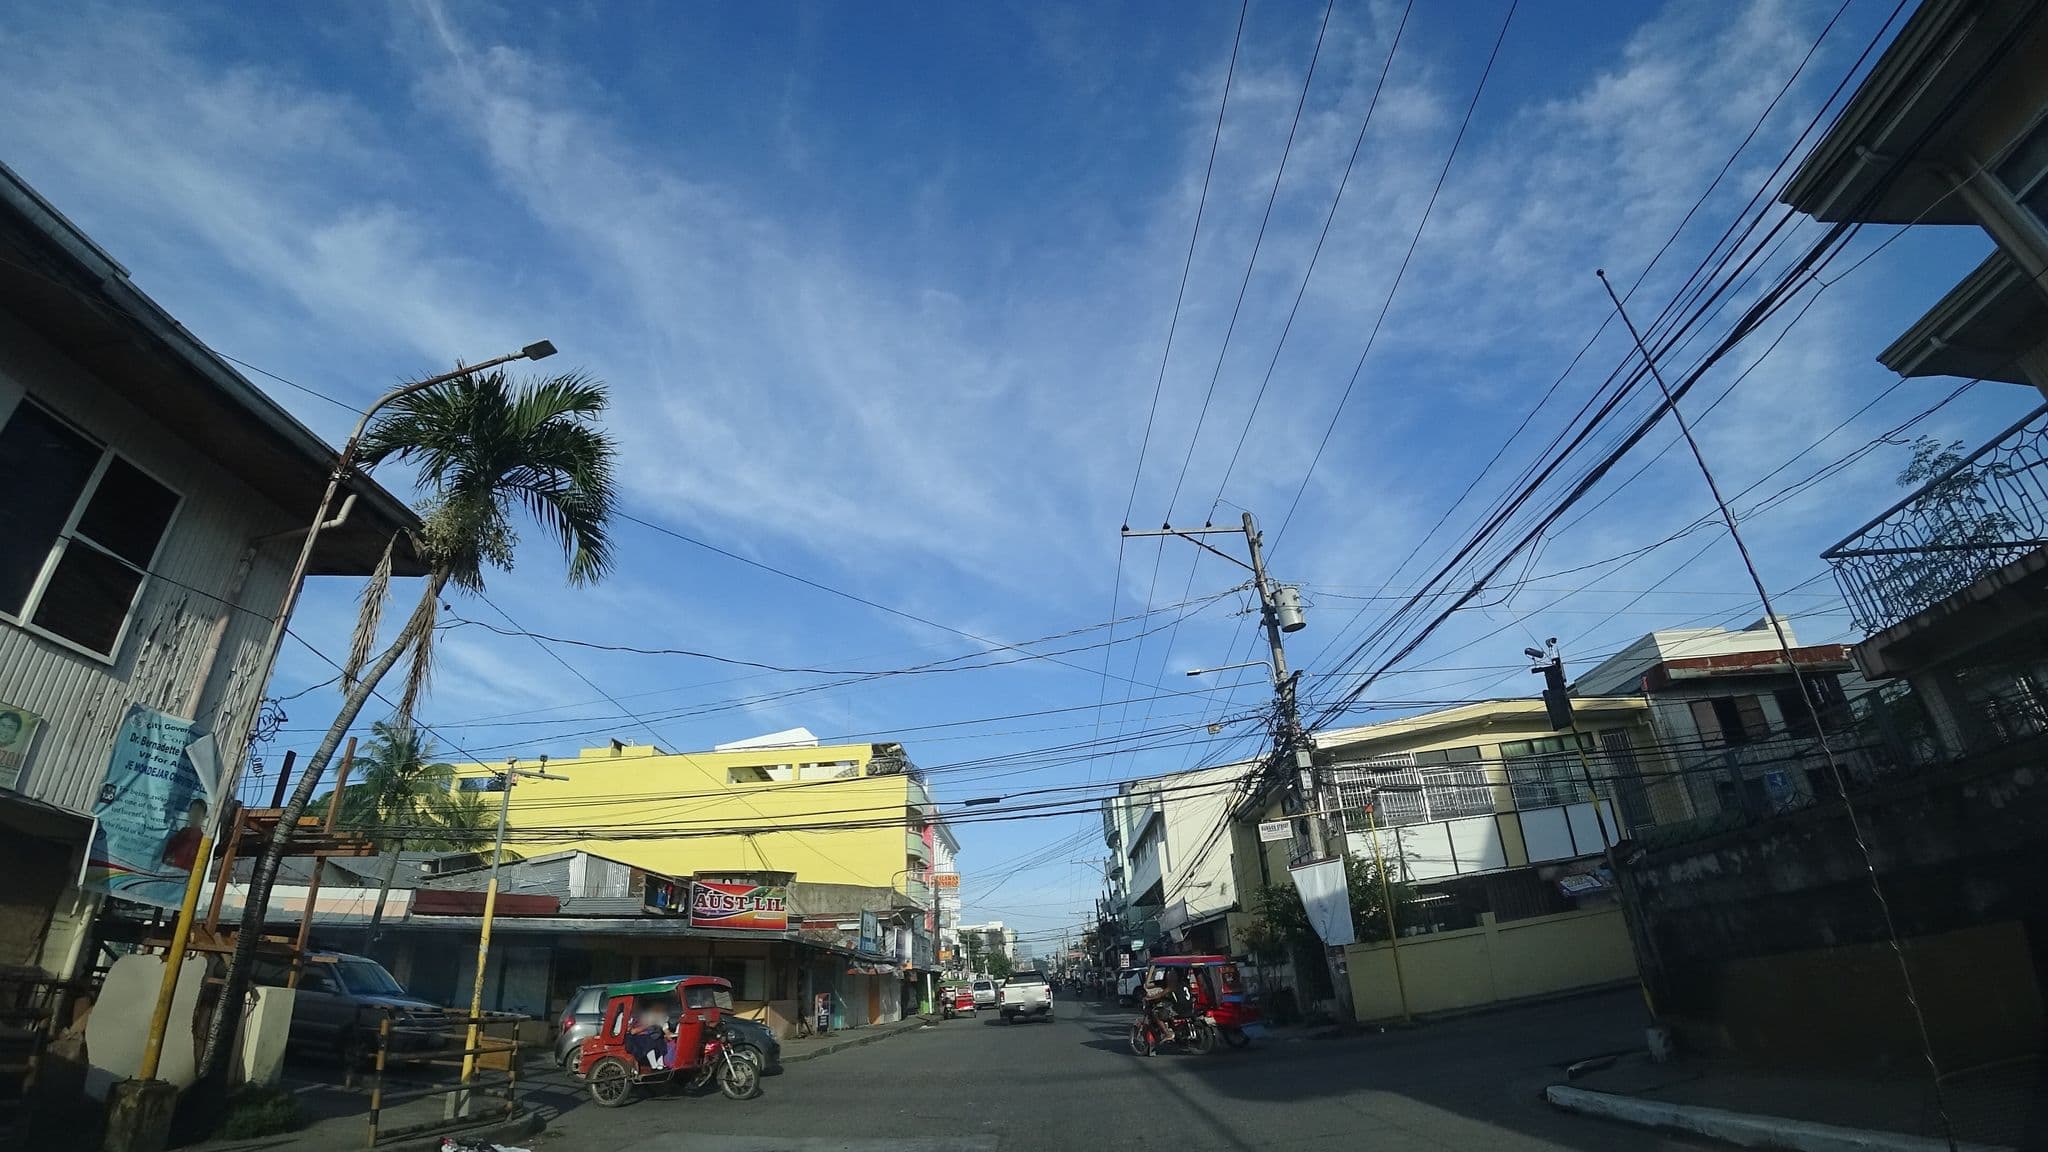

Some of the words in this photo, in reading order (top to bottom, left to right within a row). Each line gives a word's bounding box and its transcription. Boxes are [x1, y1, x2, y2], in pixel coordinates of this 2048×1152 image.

[146, 722, 162, 731] City
[129, 732, 139, 744] Dr.
[140, 736, 181, 756] Bernadette
[694, 894, 748, 909] AUST
